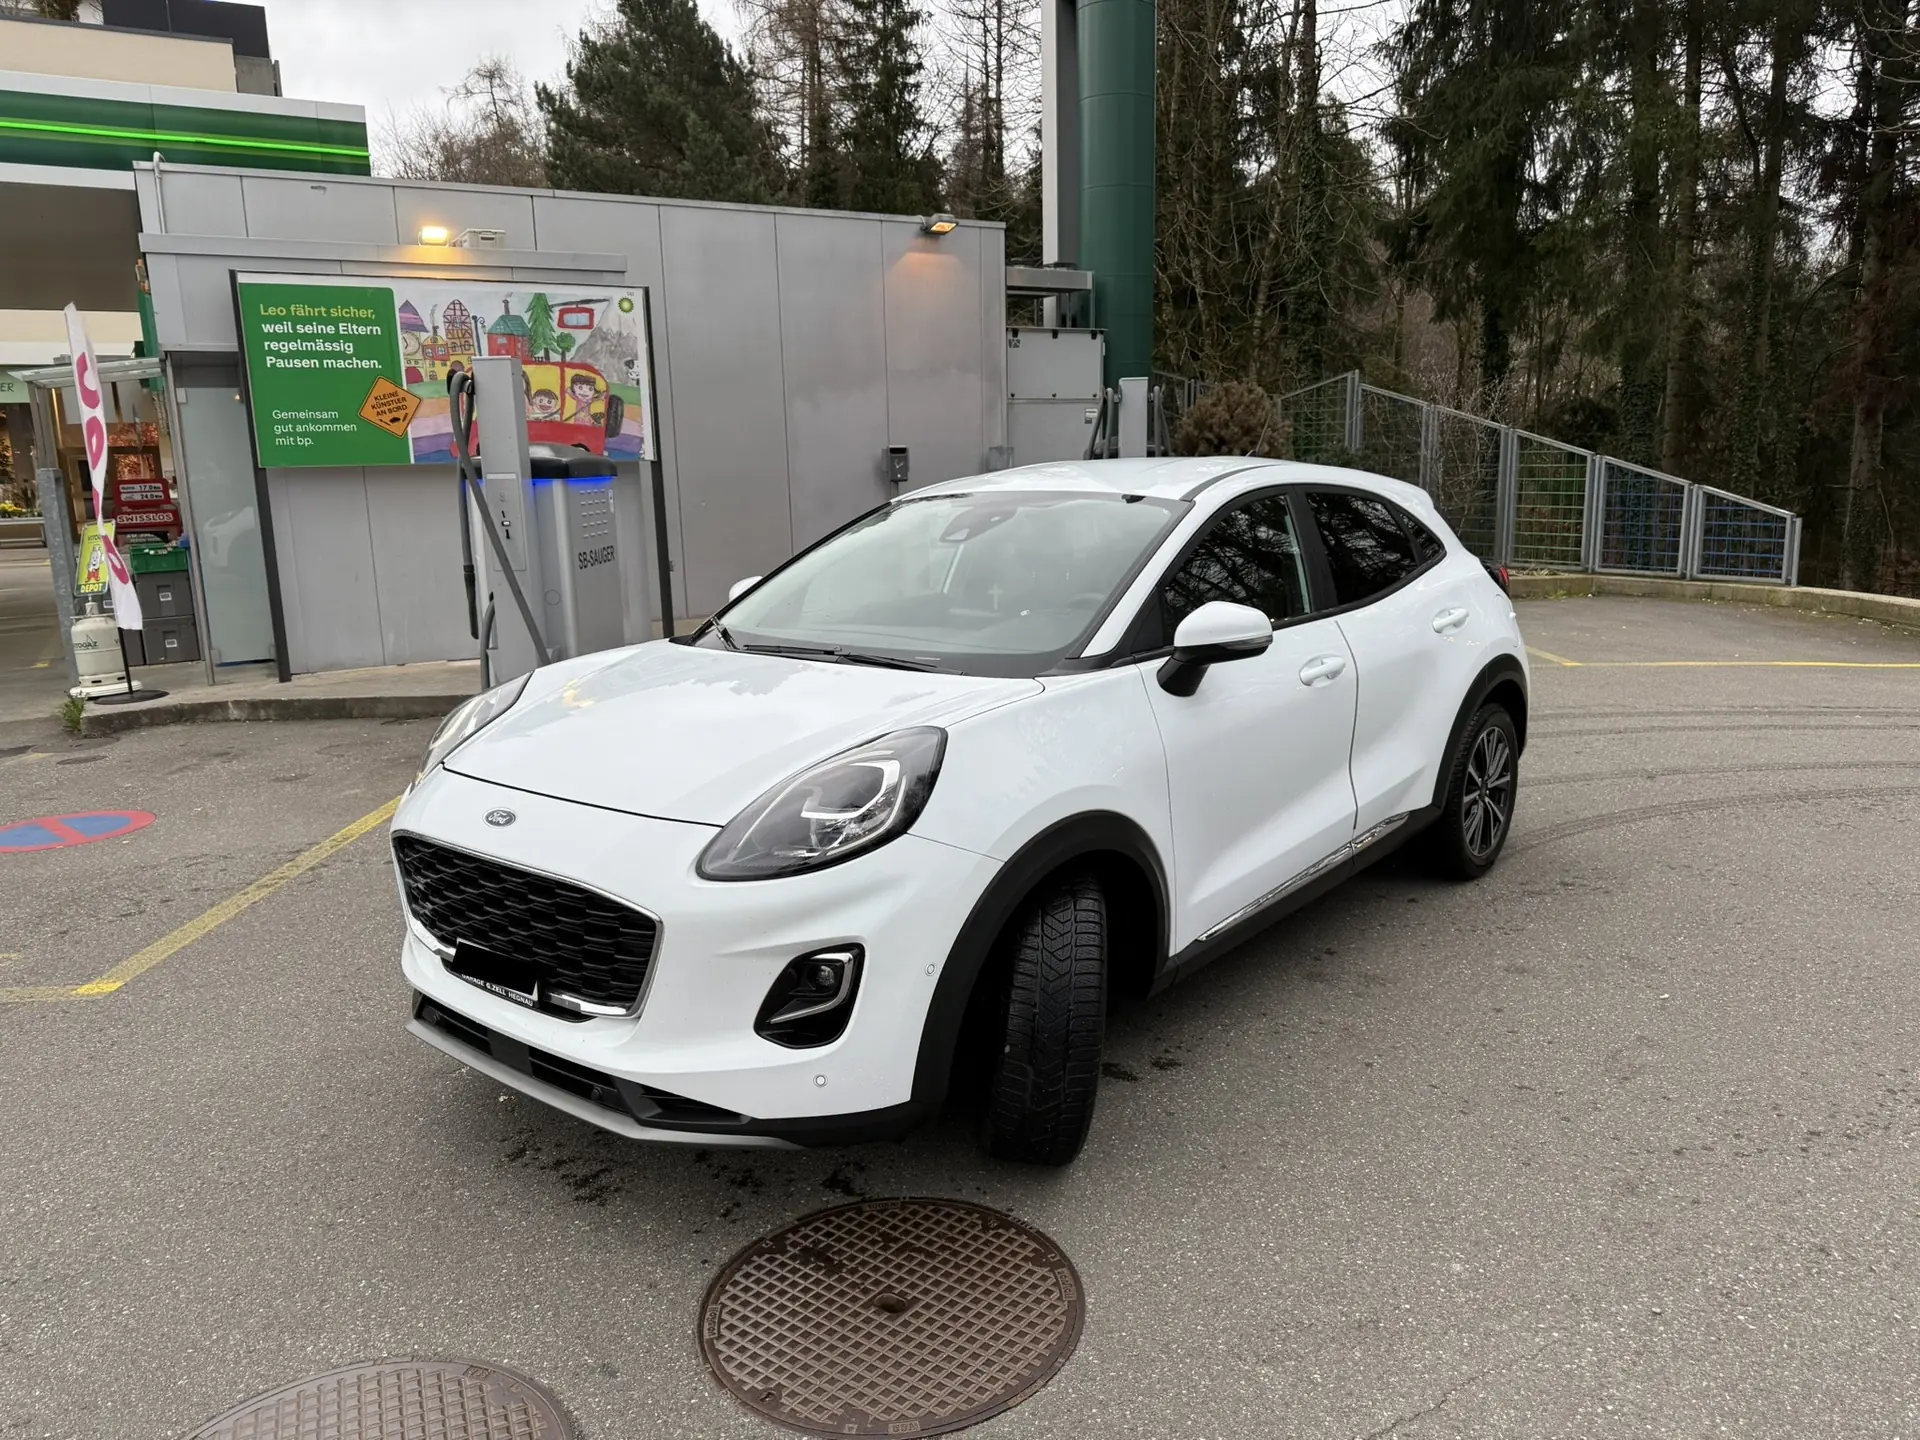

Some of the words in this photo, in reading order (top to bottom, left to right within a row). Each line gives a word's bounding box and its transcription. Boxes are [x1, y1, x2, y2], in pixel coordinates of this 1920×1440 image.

[260, 303, 286, 315] Leo
[290, 304, 327, 316] fährt
[330, 305, 375, 319] sicher,
[261, 321, 293, 333] weil
[296, 322, 335, 334] seine
[339, 322, 381, 335] Eltern
[264, 339, 354, 354] regelmässig
[266, 356, 319, 368] Pausen
[323, 357, 382, 368] machen.
[374, 390, 399, 401] KLEINE
[371, 396, 407, 410] KÜNSTLER
[387, 404, 408, 414] BORD
[272, 409, 339, 419] Gemeinsam
[273, 423, 294, 434] gut
[296, 422, 357, 432] ankommen
[275, 436, 295, 445] mit
[297, 436, 314, 447] bp.
[117, 513, 173, 523] SWISSLOS
[578, 545, 615, 570] SB-SAUGER
[80, 583, 103, 593] DEPOT
[488, 810, 510, 824] Ford
[508, 991, 533, 1006] HEGNAU
